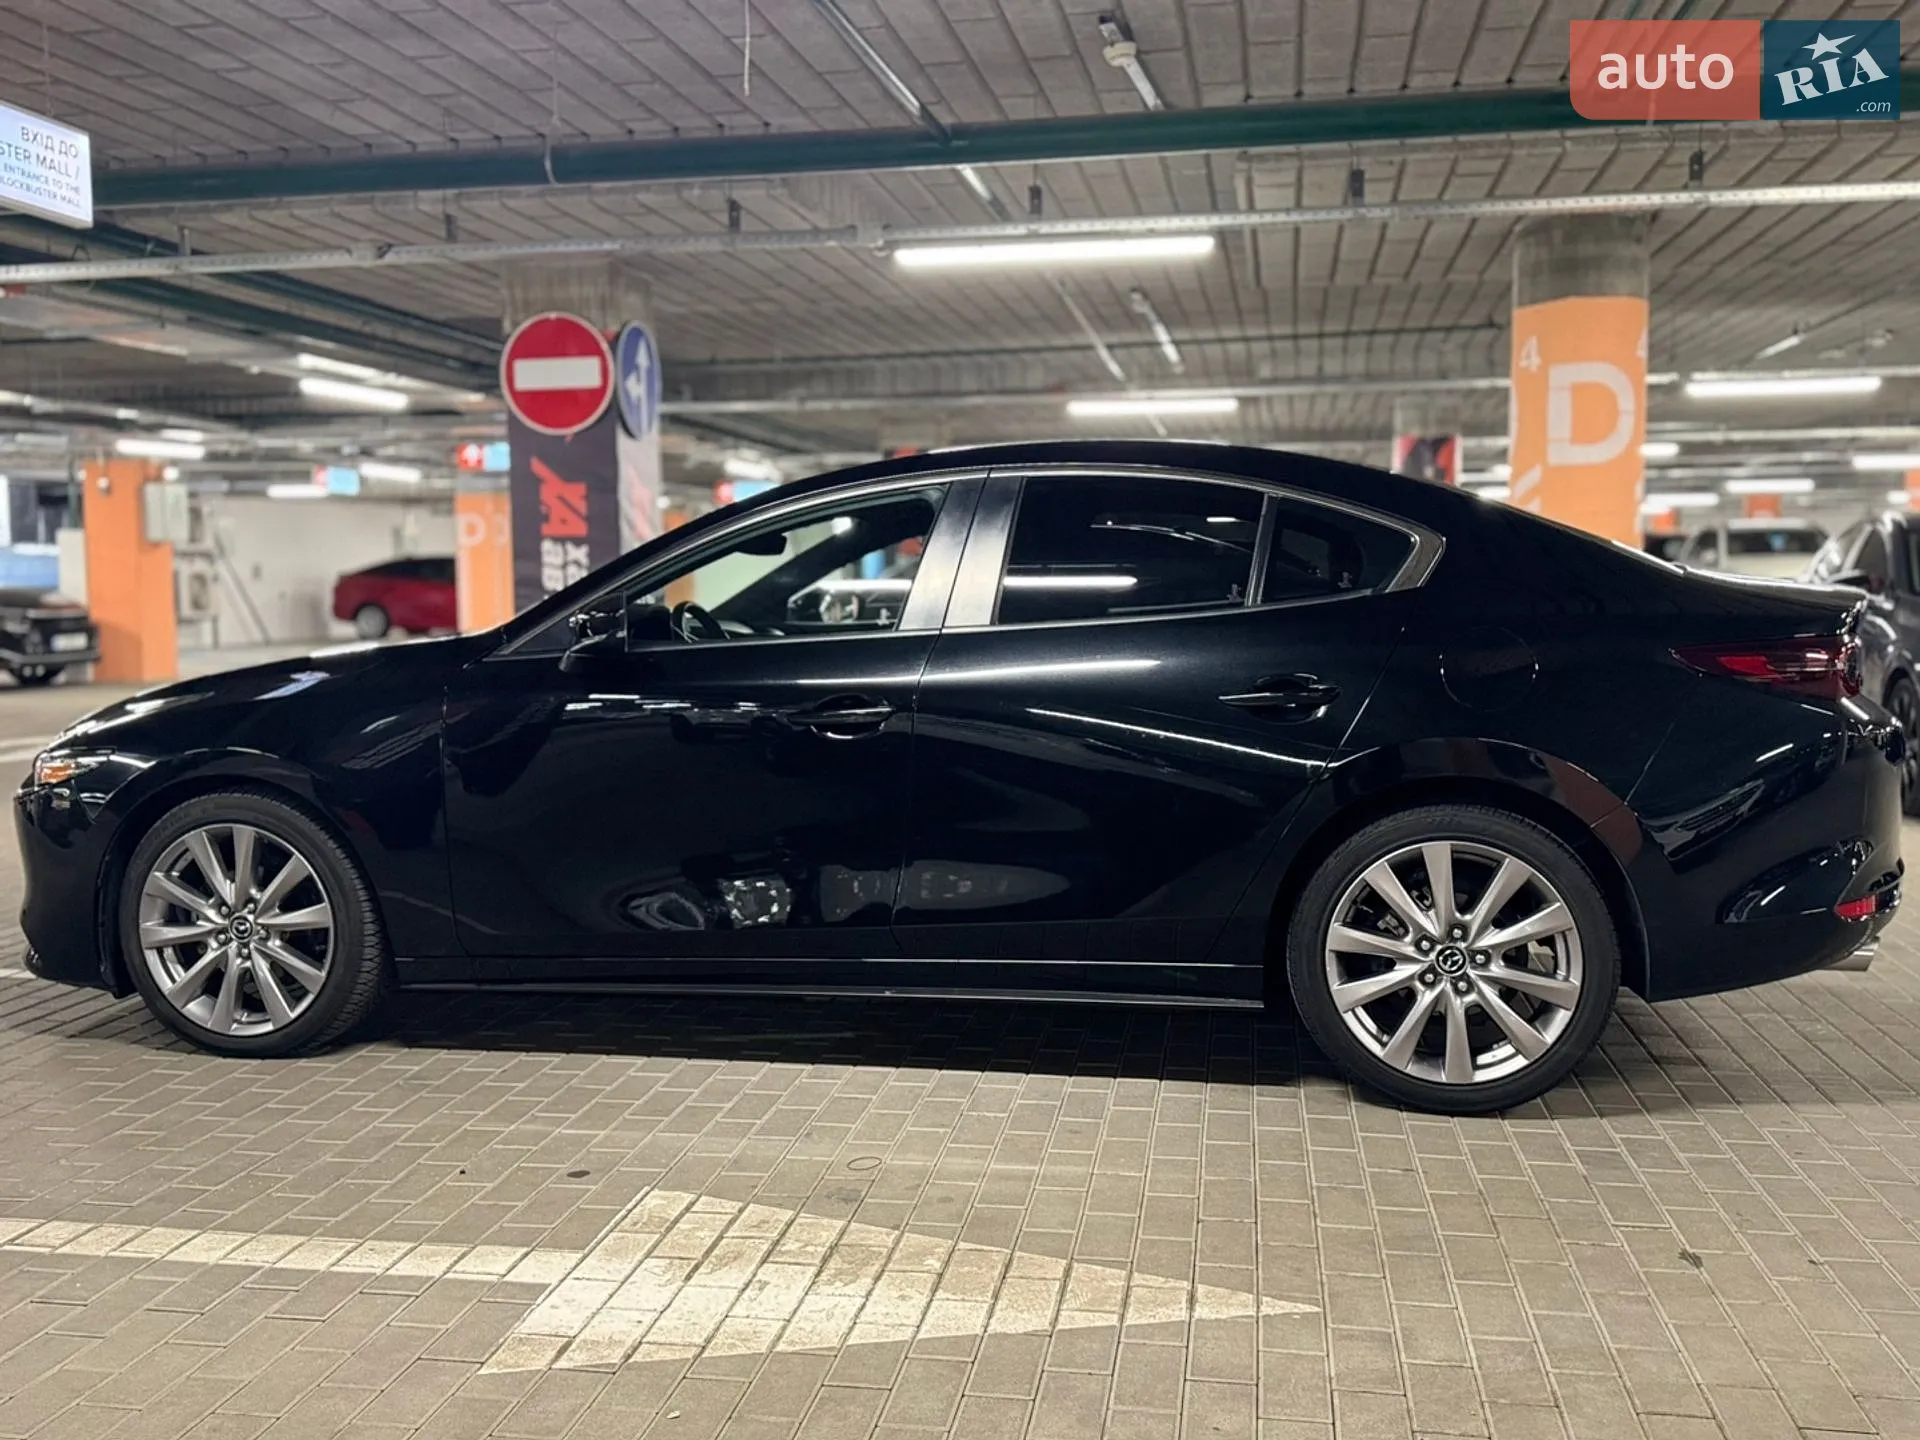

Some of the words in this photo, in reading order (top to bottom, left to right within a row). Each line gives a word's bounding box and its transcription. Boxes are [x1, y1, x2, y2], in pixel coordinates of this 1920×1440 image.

[21, 125, 55, 155] ВХІД
[58, 139, 79, 159] ДО
[3, 161, 49, 186] ENTRANCE
[52, 178, 64, 190] TO
[64, 182, 81, 196] THE
[36, 152, 72, 178] MALL
[1519, 335, 1541, 372] 4
[1547, 361, 1635, 465] D
